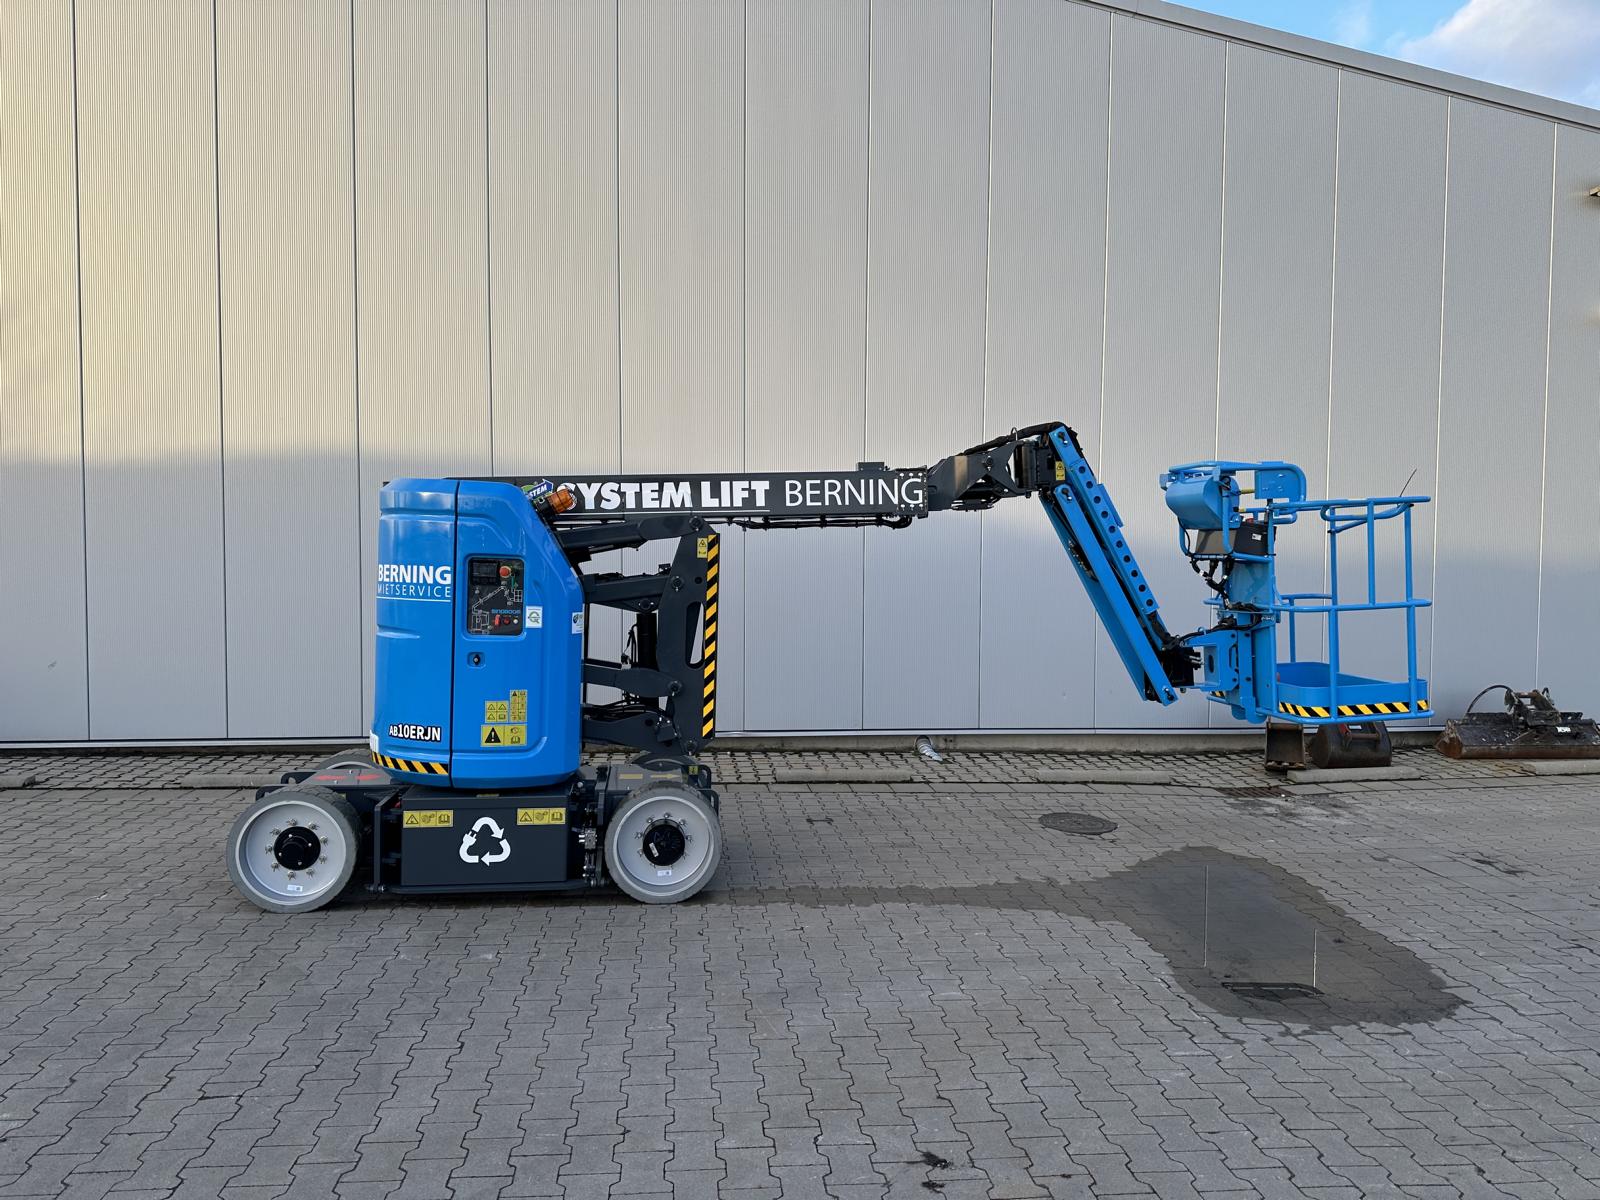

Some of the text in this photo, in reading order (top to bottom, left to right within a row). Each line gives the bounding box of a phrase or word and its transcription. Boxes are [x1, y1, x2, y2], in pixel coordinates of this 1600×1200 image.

[527, 483, 548, 500] STEM
[701, 480, 770, 508] LIFT
[785, 478, 923, 507] BERNING
[378, 564, 452, 585] BERNING
[388, 723, 441, 742] AB10ERJN
